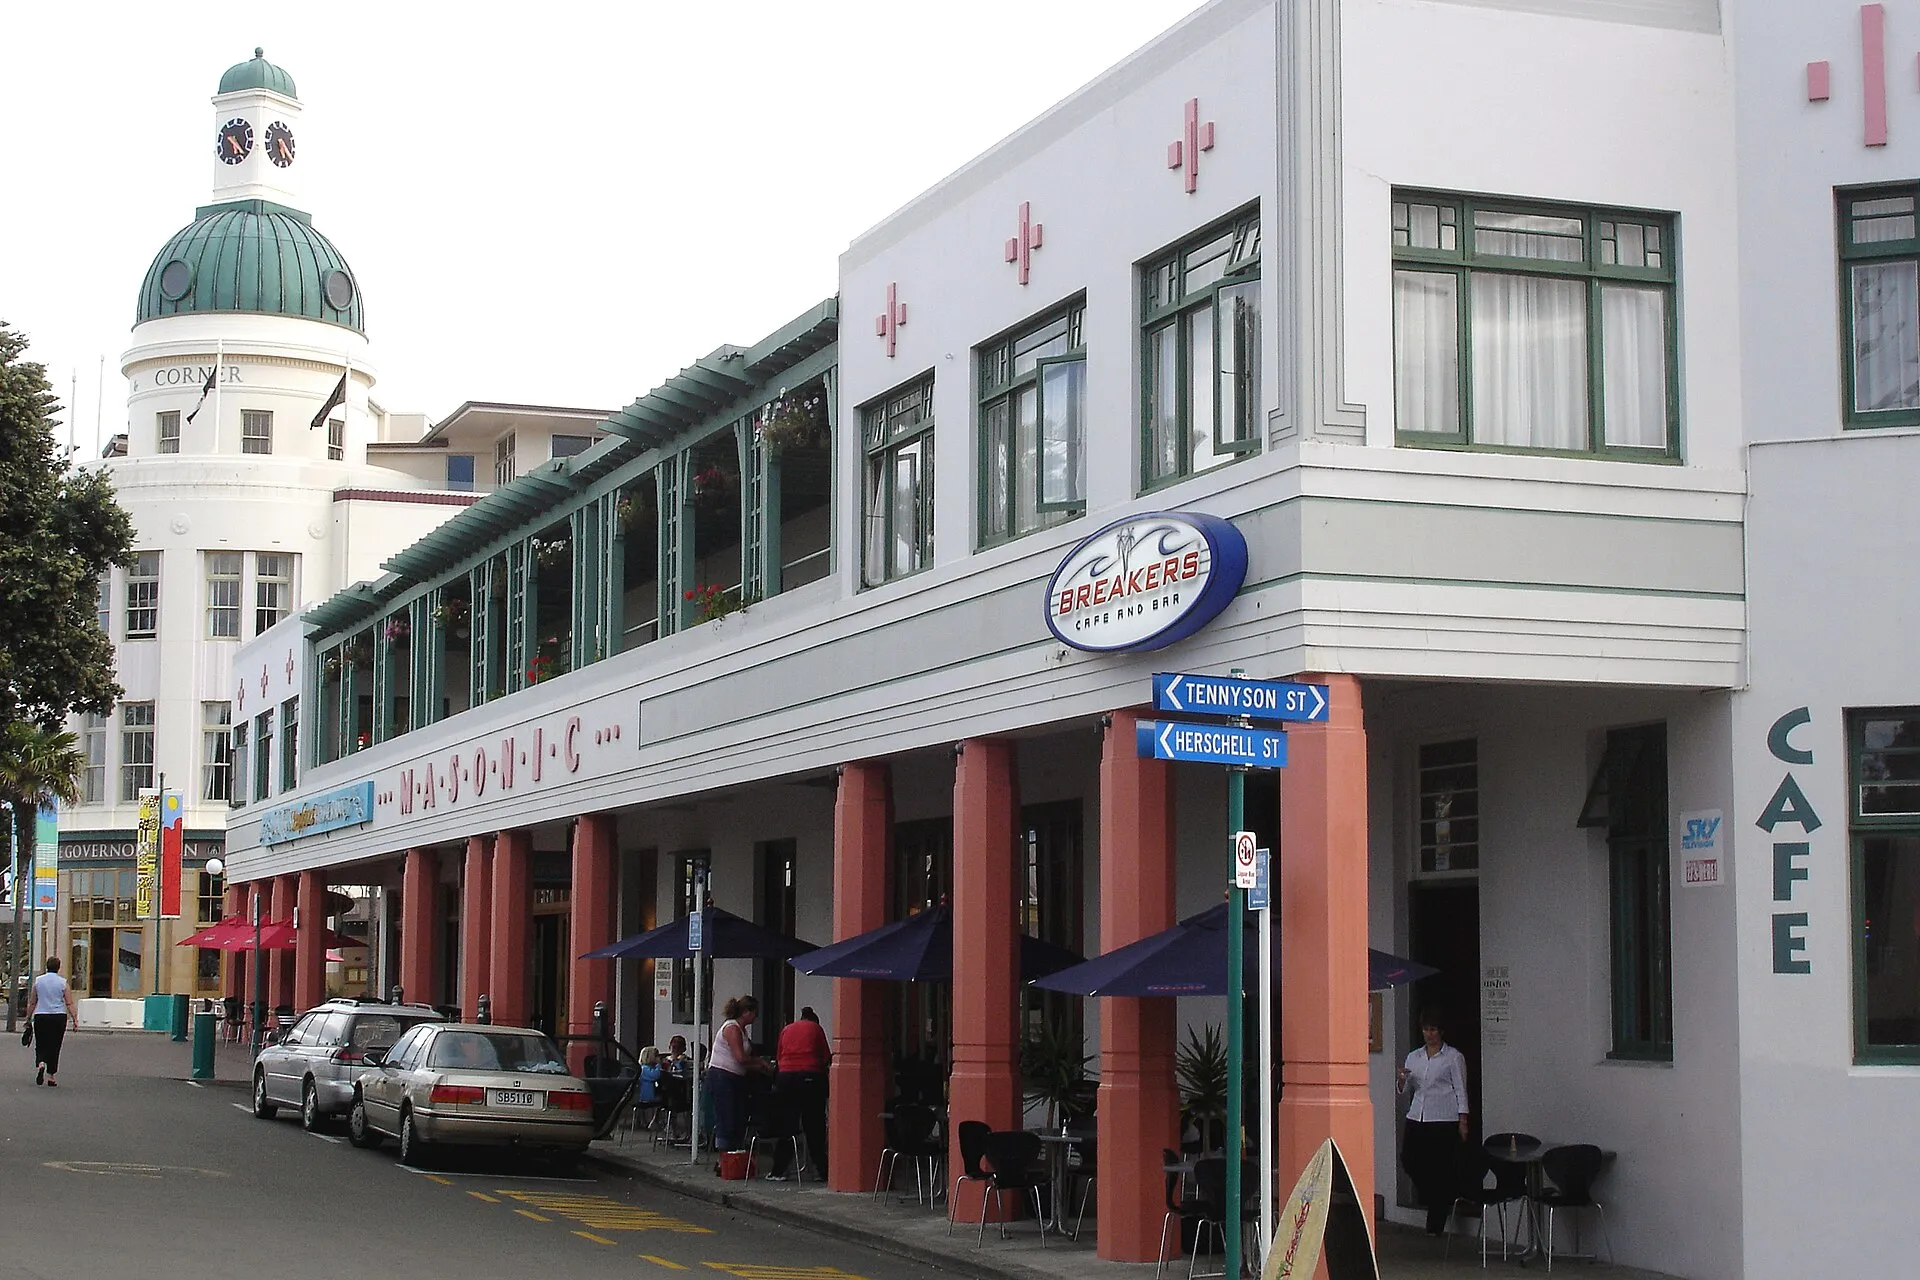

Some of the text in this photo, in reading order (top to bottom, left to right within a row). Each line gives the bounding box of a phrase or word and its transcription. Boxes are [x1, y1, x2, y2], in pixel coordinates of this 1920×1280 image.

[1058, 551, 1199, 615] BREAKERS
[1075, 593, 1180, 631] CAFE AND BAR
[1186, 682, 1306, 712] TENNYSON ST
[1175, 730, 1279, 759] HERSCHELL ST
[1682, 817, 1721, 840] SKY
[1755, 705, 1822, 974] CAFE
[65, 843, 138, 859] GOVERNO
[497, 1092, 533, 1104] SB5110
